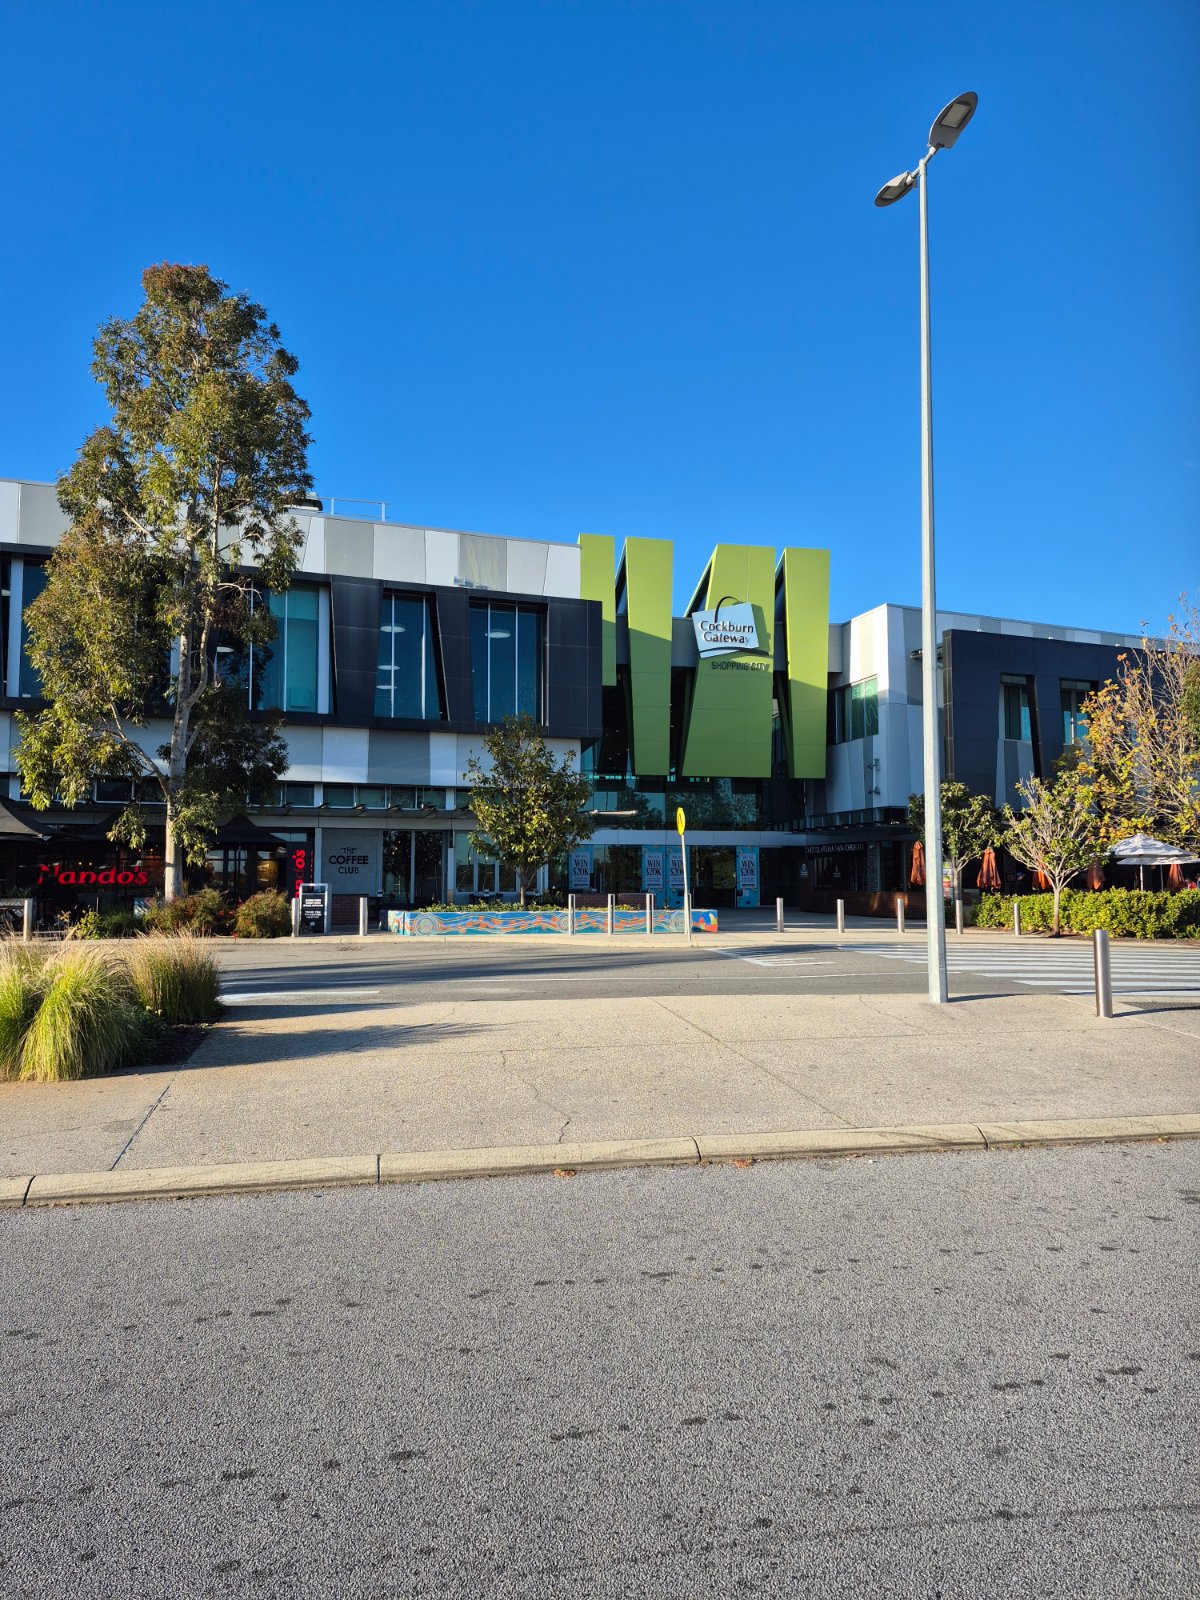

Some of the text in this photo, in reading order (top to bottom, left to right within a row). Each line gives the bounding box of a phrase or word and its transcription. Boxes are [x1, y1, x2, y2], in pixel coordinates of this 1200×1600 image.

[701, 621, 754, 633] Cockburn
[704, 632, 751, 645] Gateway
[711, 661, 770, 671] SHOPPING CITY
[329, 855, 368, 864] COFFEE
[647, 859, 661, 867] WIN
[741, 859, 755, 867] WIN
[292, 849, 305, 899] ndo's
[338, 866, 359, 874] CLUB
